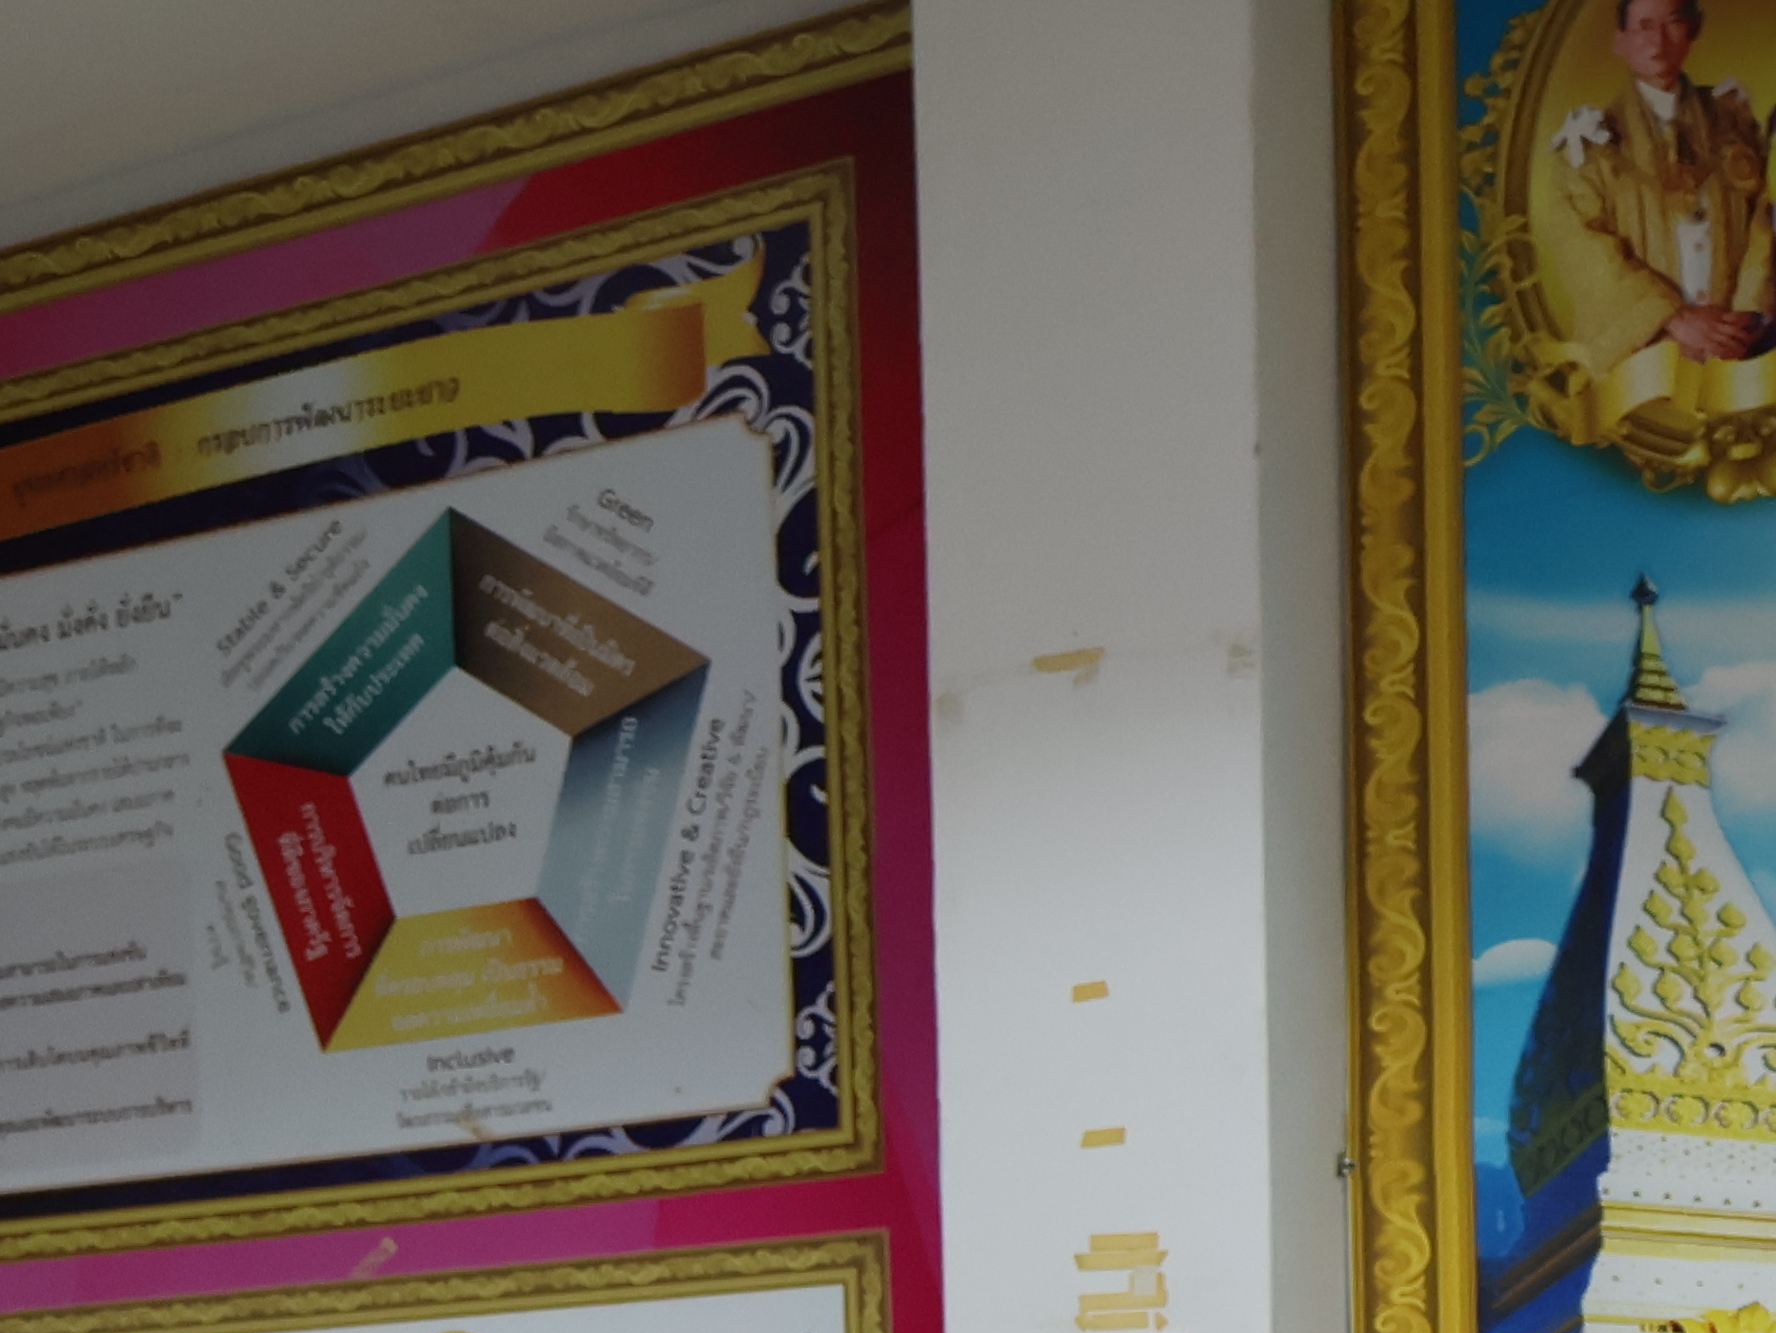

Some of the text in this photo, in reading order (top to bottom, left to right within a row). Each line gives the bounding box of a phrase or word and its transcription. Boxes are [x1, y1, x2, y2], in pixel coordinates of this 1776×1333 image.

[596, 487, 656, 534] Green
[215, 597, 269, 659] Stable
[285, 519, 344, 579] Secure
[687, 717, 726, 819] Creative
[680, 822, 701, 843] &
[651, 849, 693, 974] Innovative
[426, 1045, 516, 1074] Inclusive
